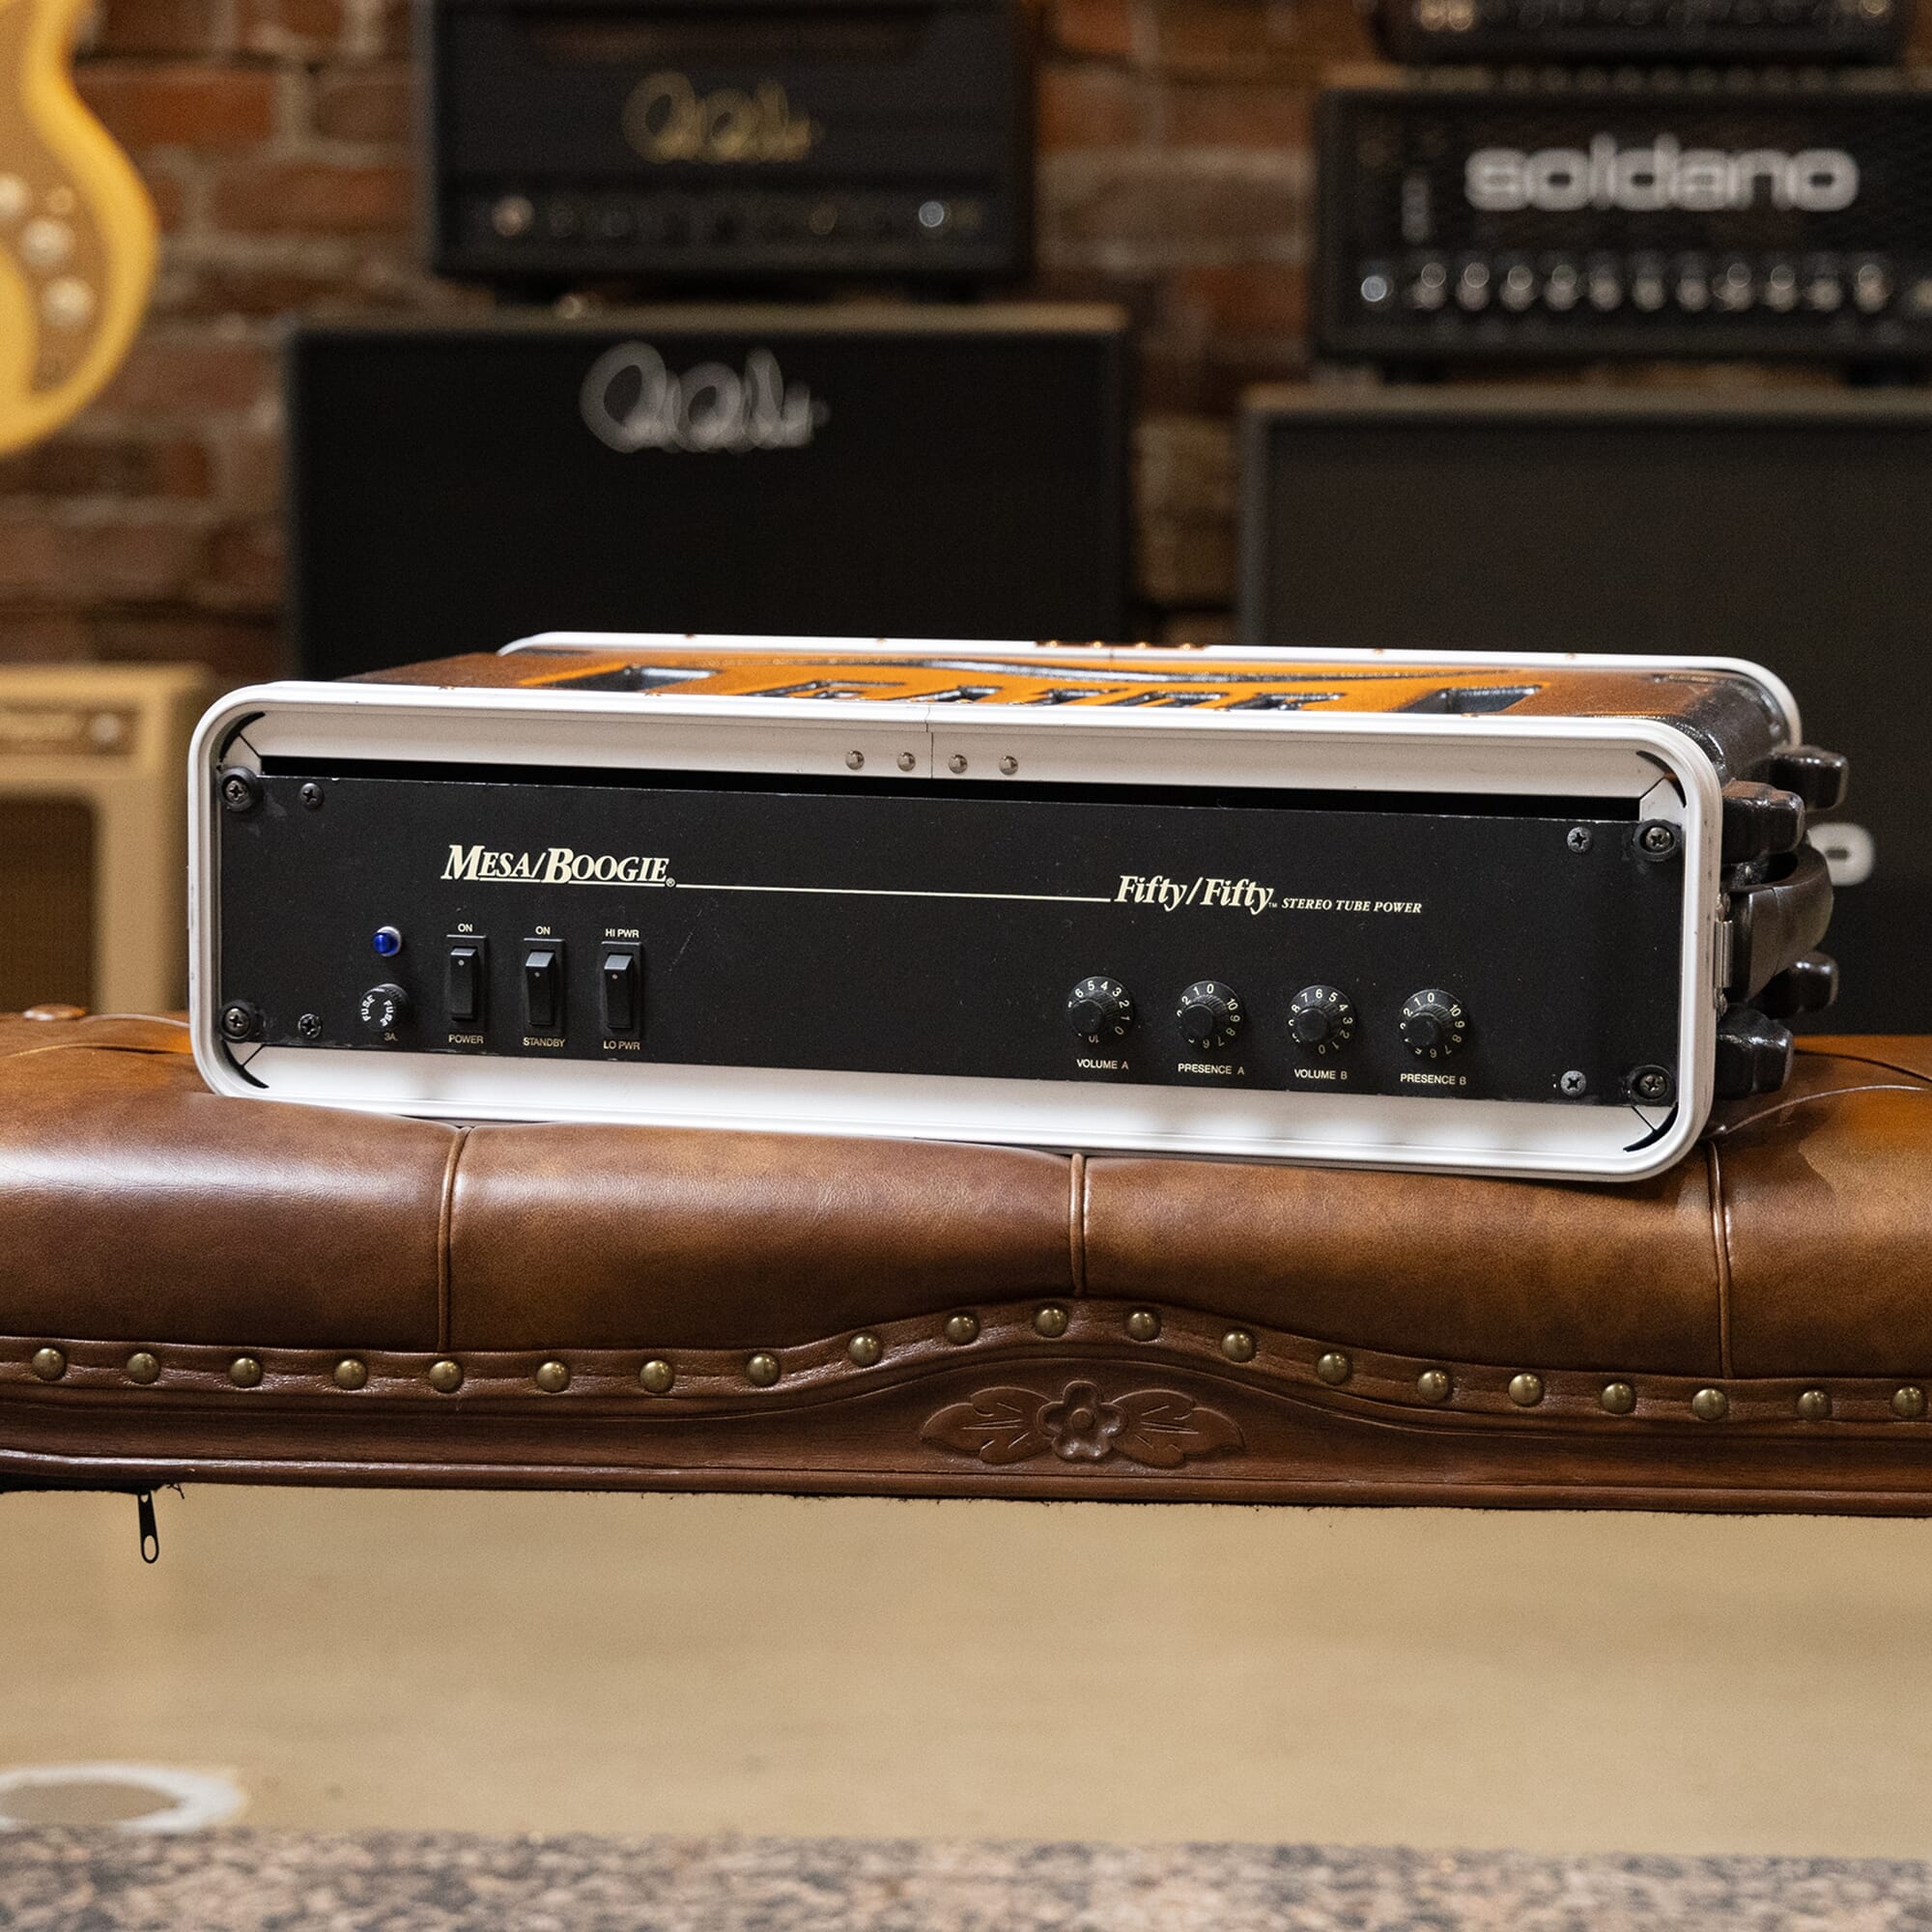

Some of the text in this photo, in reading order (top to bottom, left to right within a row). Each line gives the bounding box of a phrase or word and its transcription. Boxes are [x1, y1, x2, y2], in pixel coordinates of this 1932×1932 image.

[1464, 131, 1860, 212] soldano
[1114, 874, 1274, 916] Fifty/Fifty
[1282, 897, 1422, 914] STEREO TUBE POWER
[458, 923, 473, 933] ON
[535, 926, 551, 935] ON
[606, 928, 640, 939] HI PWR
[361, 995, 376, 1022] FUSE
[380, 1000, 394, 1027] FUSE
[448, 1035, 484, 1044] POWER
[523, 1037, 566, 1048] STANDBY
[603, 1040, 640, 1051] LO PWR
[1077, 1059, 1129, 1069] VOLUME A
[1178, 1063, 1245, 1075] PRESENCE A
[1294, 1068, 1348, 1080] VOLUME B
[1401, 1073, 1467, 1086] PRESENCE B
